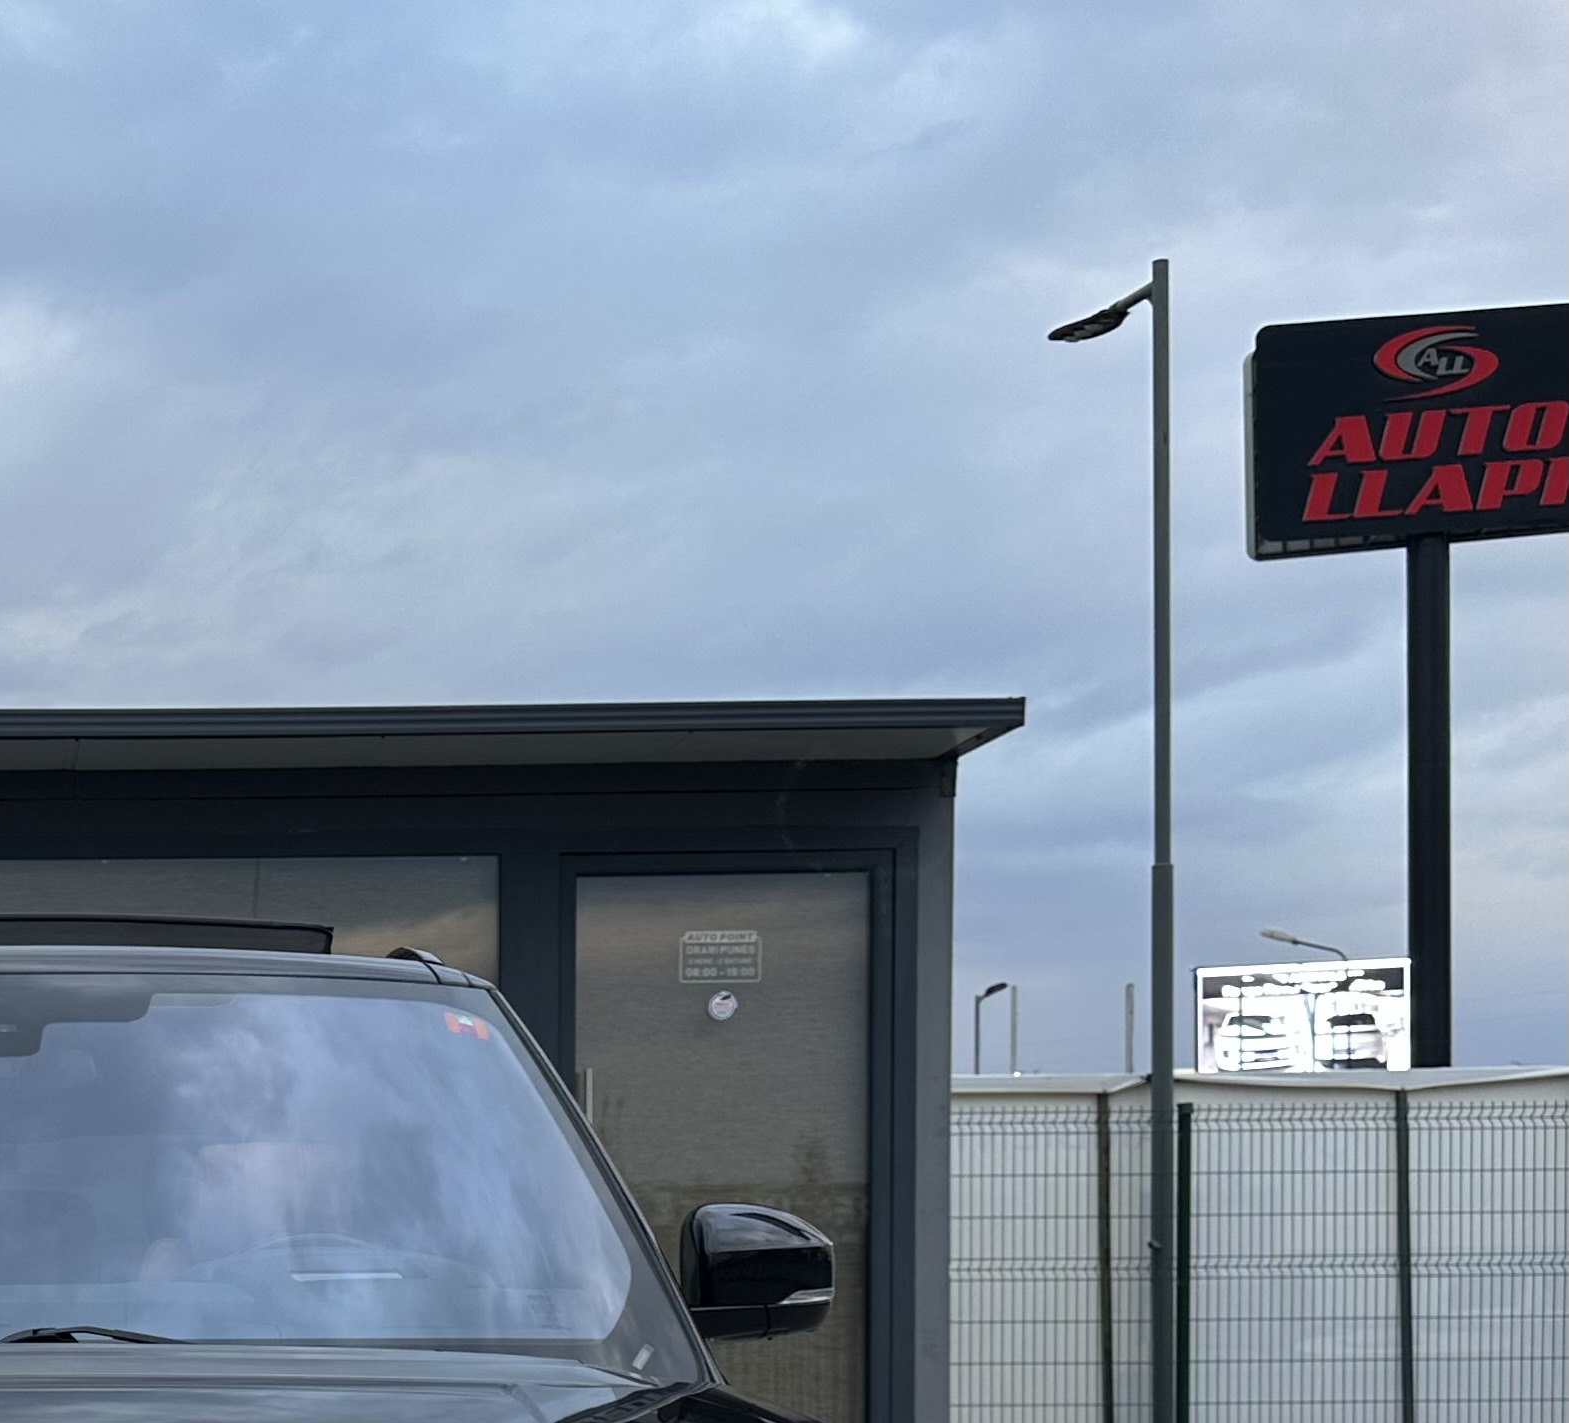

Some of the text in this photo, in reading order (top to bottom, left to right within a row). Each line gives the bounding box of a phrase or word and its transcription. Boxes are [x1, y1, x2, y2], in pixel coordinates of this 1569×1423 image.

[1417, 347, 1470, 376] ALL
[1306, 400, 1568, 467] AUTO
[687, 932, 754, 941] AUTO POINT
